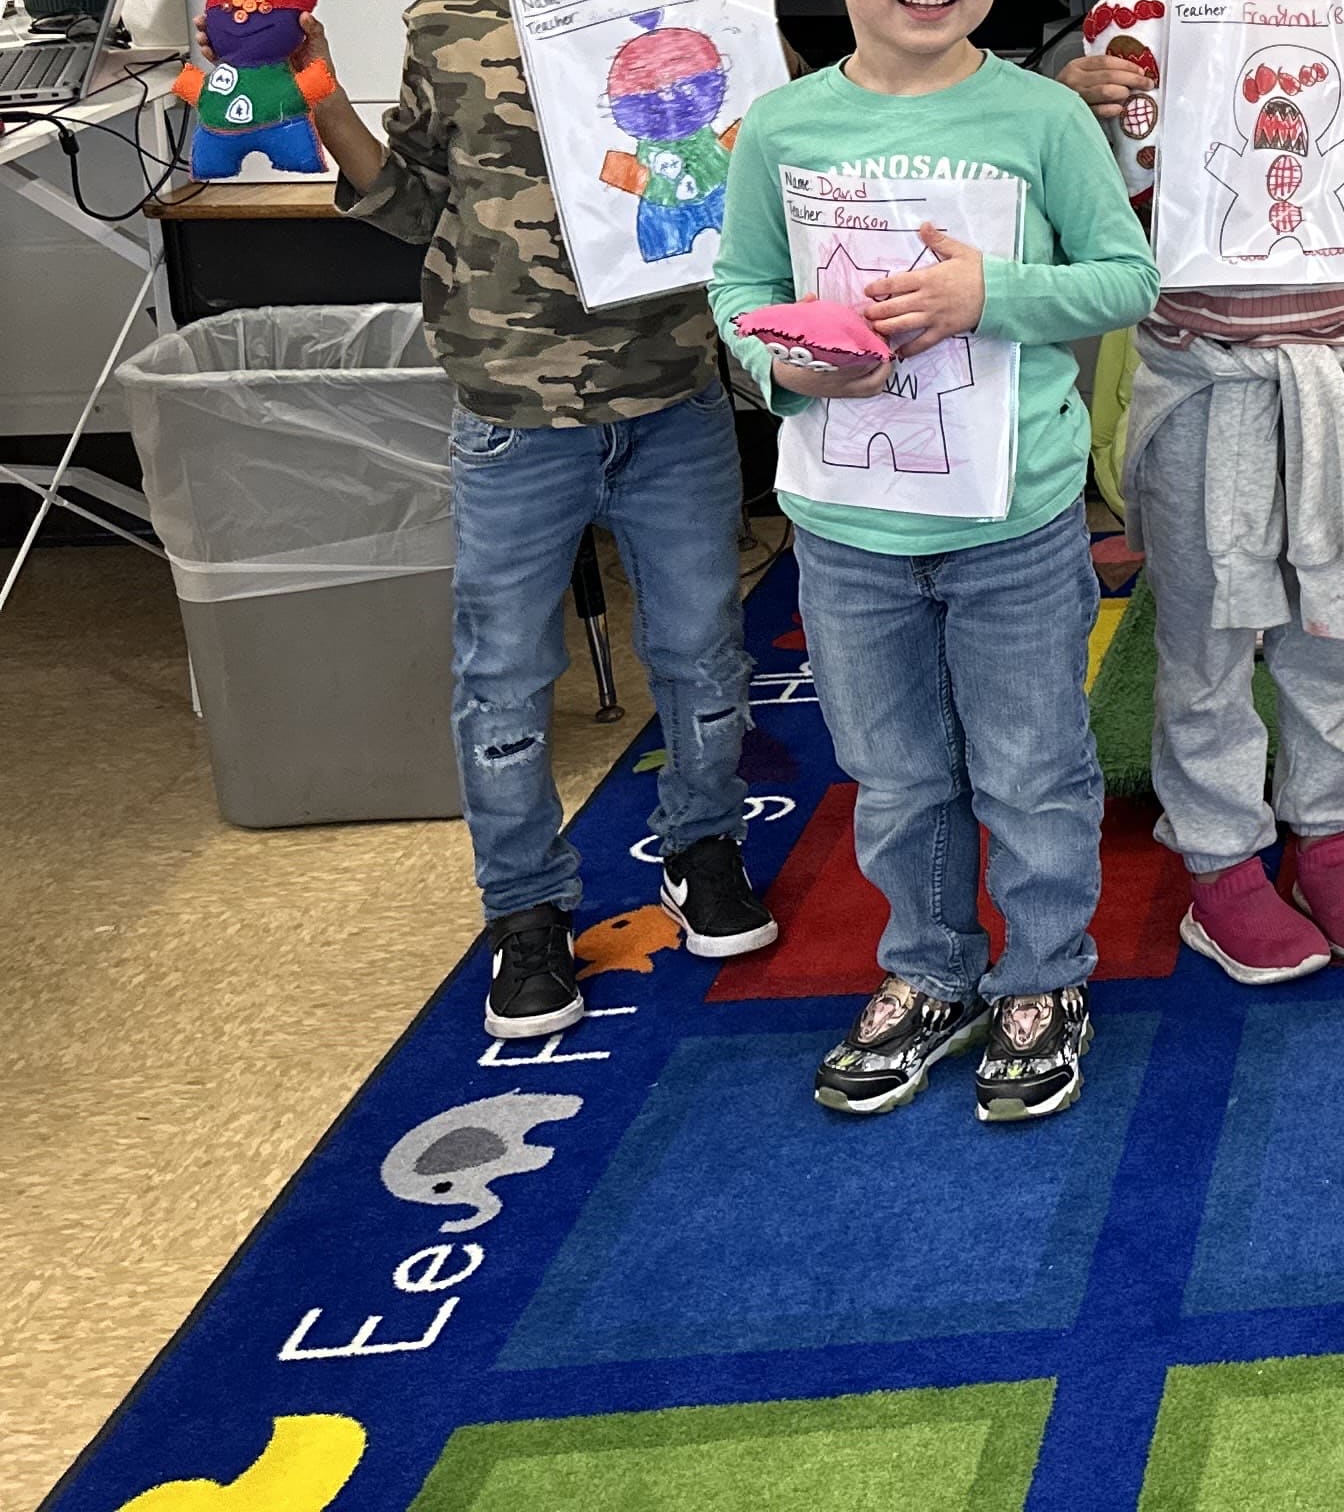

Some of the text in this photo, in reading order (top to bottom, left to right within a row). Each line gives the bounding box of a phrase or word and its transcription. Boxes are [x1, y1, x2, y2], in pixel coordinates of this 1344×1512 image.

[526, 10, 578, 36] Teacher
[817, 176, 867, 201] David
[834, 206, 889, 230] Benson
[277, 1240, 487, 1363] Ee
